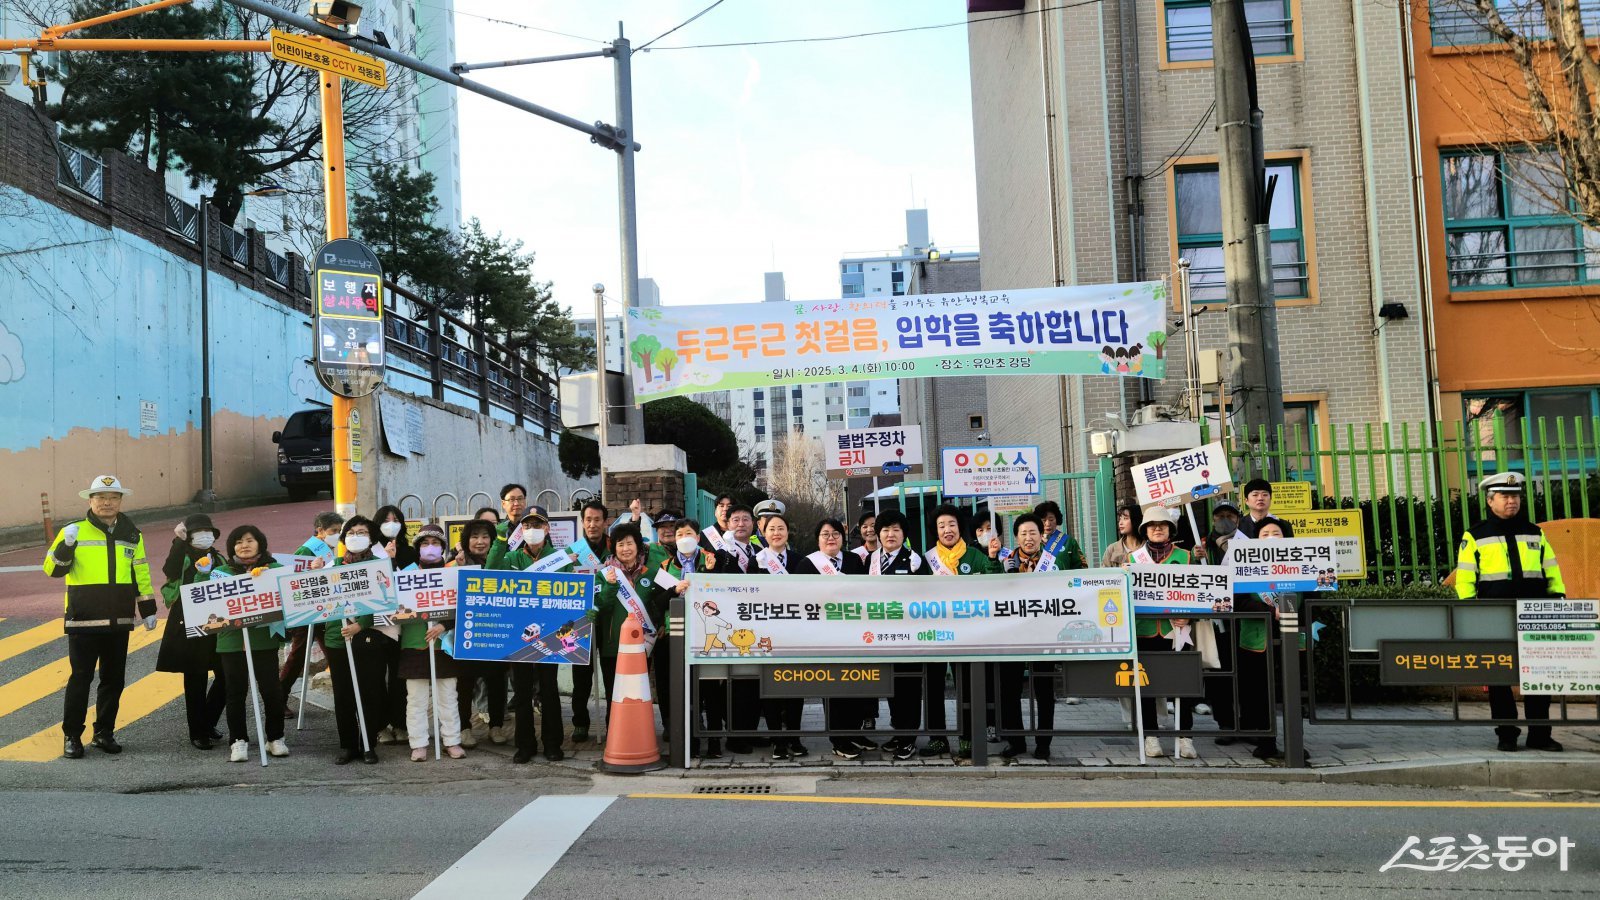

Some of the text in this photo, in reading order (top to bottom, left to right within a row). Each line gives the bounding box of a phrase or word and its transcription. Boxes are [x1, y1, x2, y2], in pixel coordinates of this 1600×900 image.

[276, 42, 381, 80] 어린이보호용 CCTV 작동중
[359, 259, 373, 269] 남구
[324, 294, 377, 312] 상시주의
[902, 298, 936, 309] 키우는
[676, 309, 1129, 364] 두근두근 첫걸음, 입학을 축하합니다
[772, 368, 794, 379] 일시
[885, 361, 915, 372] 10:00
[940, 359, 963, 370] 장소
[973, 358, 1004, 369] 유안초
[1009, 357, 1031, 368] 강당
[838, 431, 906, 449] 불법주정차
[839, 450, 866, 467] 금지
[1144, 451, 1208, 483] 불법주정차
[1148, 479, 1175, 499] 금지
[1288, 518, 1307, 528] 시설
[1316, 517, 1349, 527] 지진겸용
[1234, 546, 1331, 563] 어린이보호구역
[1235, 564, 1319, 576] 제한속도 30km 준수
[290, 568, 368, 590] 일단멈춤 이쪽저쪽
[394, 572, 443, 591] 단보도
[465, 577, 532, 595] 교통사고
[190, 577, 255, 604] 횡단보도
[292, 580, 370, 601] 삼초동안 사고예방
[1166, 590, 1195, 601] 30km
[1197, 592, 1215, 602] 준수
[465, 595, 586, 610] 광주시민이 모두 함께해요!
[737, 598, 1081, 621] 횡단보도 앞 일단 멈춤 아이 먼저 보내주세요.
[1524, 602, 1594, 612] 포인트펜싱클럽
[877, 629, 955, 642] 광주광역시 아이먼저
[1395, 654, 1513, 669] 어린이보호구역
[773, 669, 880, 682] SCHOOL ZONE
[1522, 682, 1600, 692] Safety Zone
